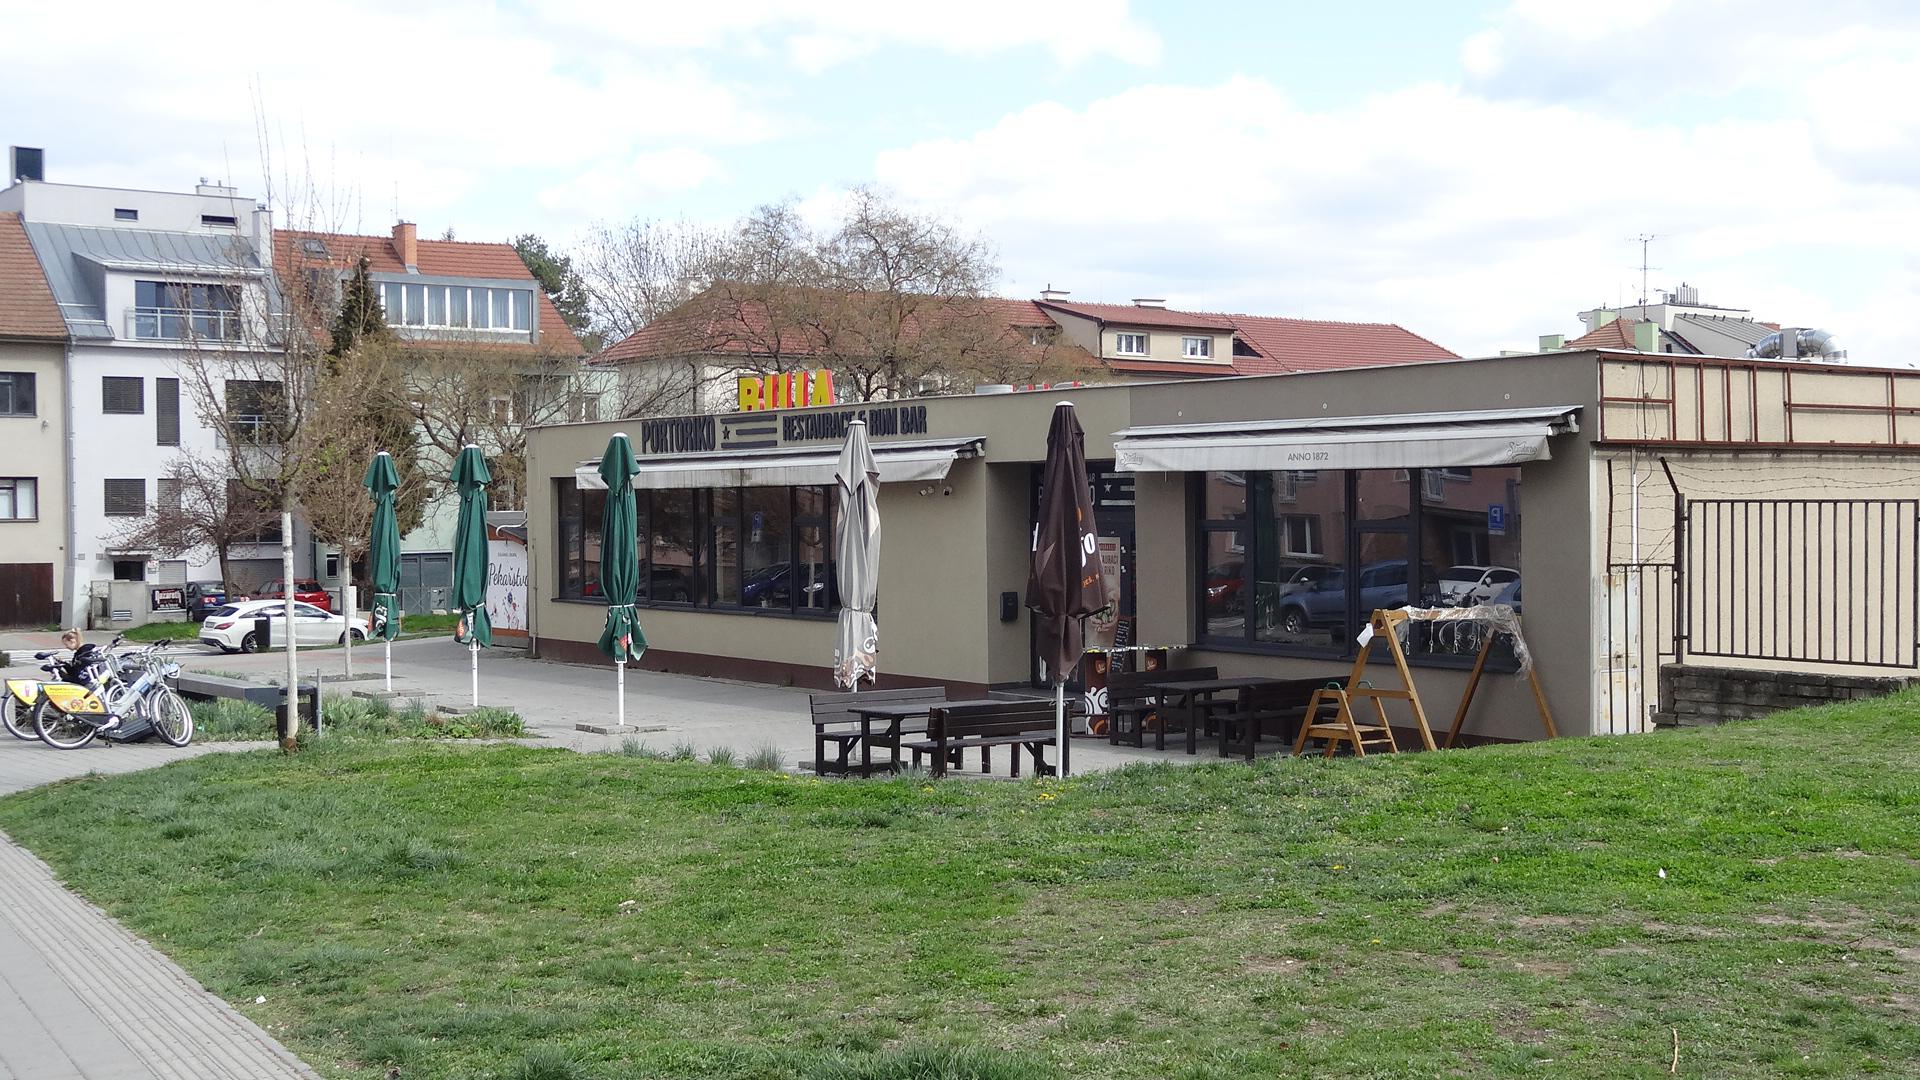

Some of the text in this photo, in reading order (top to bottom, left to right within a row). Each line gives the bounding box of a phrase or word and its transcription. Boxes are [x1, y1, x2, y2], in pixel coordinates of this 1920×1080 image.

[739, 368, 835, 412] BILLA
[641, 415, 716, 454] PORTORIKO
[869, 407, 898, 436] RUM
[900, 405, 927, 434] BAR
[1288, 451, 1329, 462] ANNO 1872
